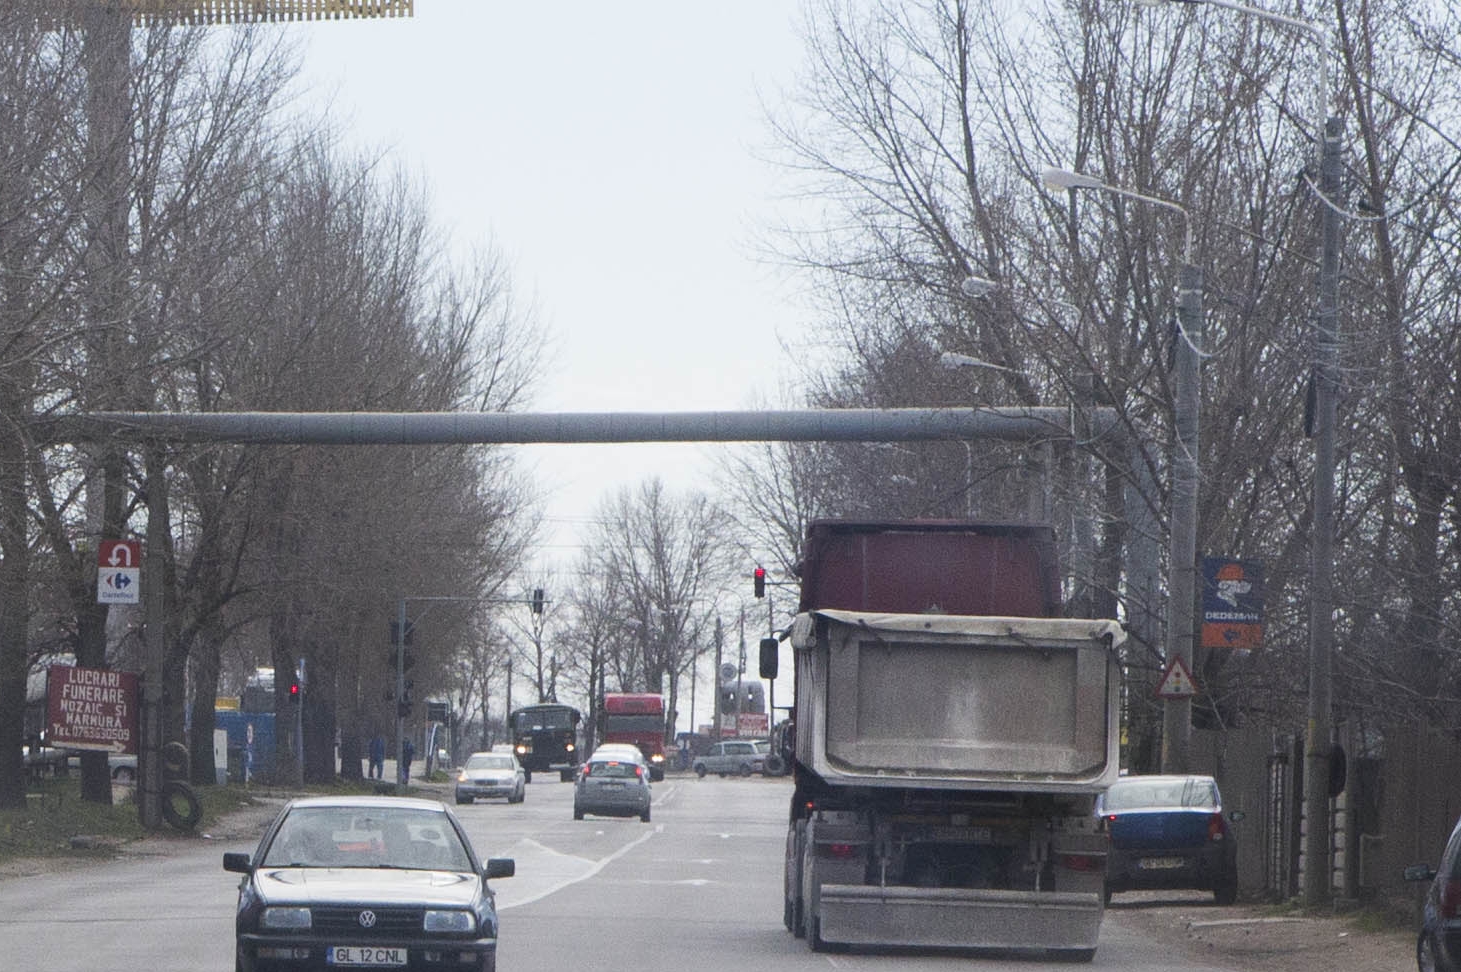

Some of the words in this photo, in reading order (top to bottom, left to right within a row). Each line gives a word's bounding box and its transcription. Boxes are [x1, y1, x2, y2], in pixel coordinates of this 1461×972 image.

[69, 668, 120, 687] LUCRARI
[62, 683, 125, 704] FUNERARE
[60, 699, 103, 714] MOZAIC
[336, 949, 354, 962] GL
[360, 949, 373, 962] 12
[376, 949, 403, 963] CNL
